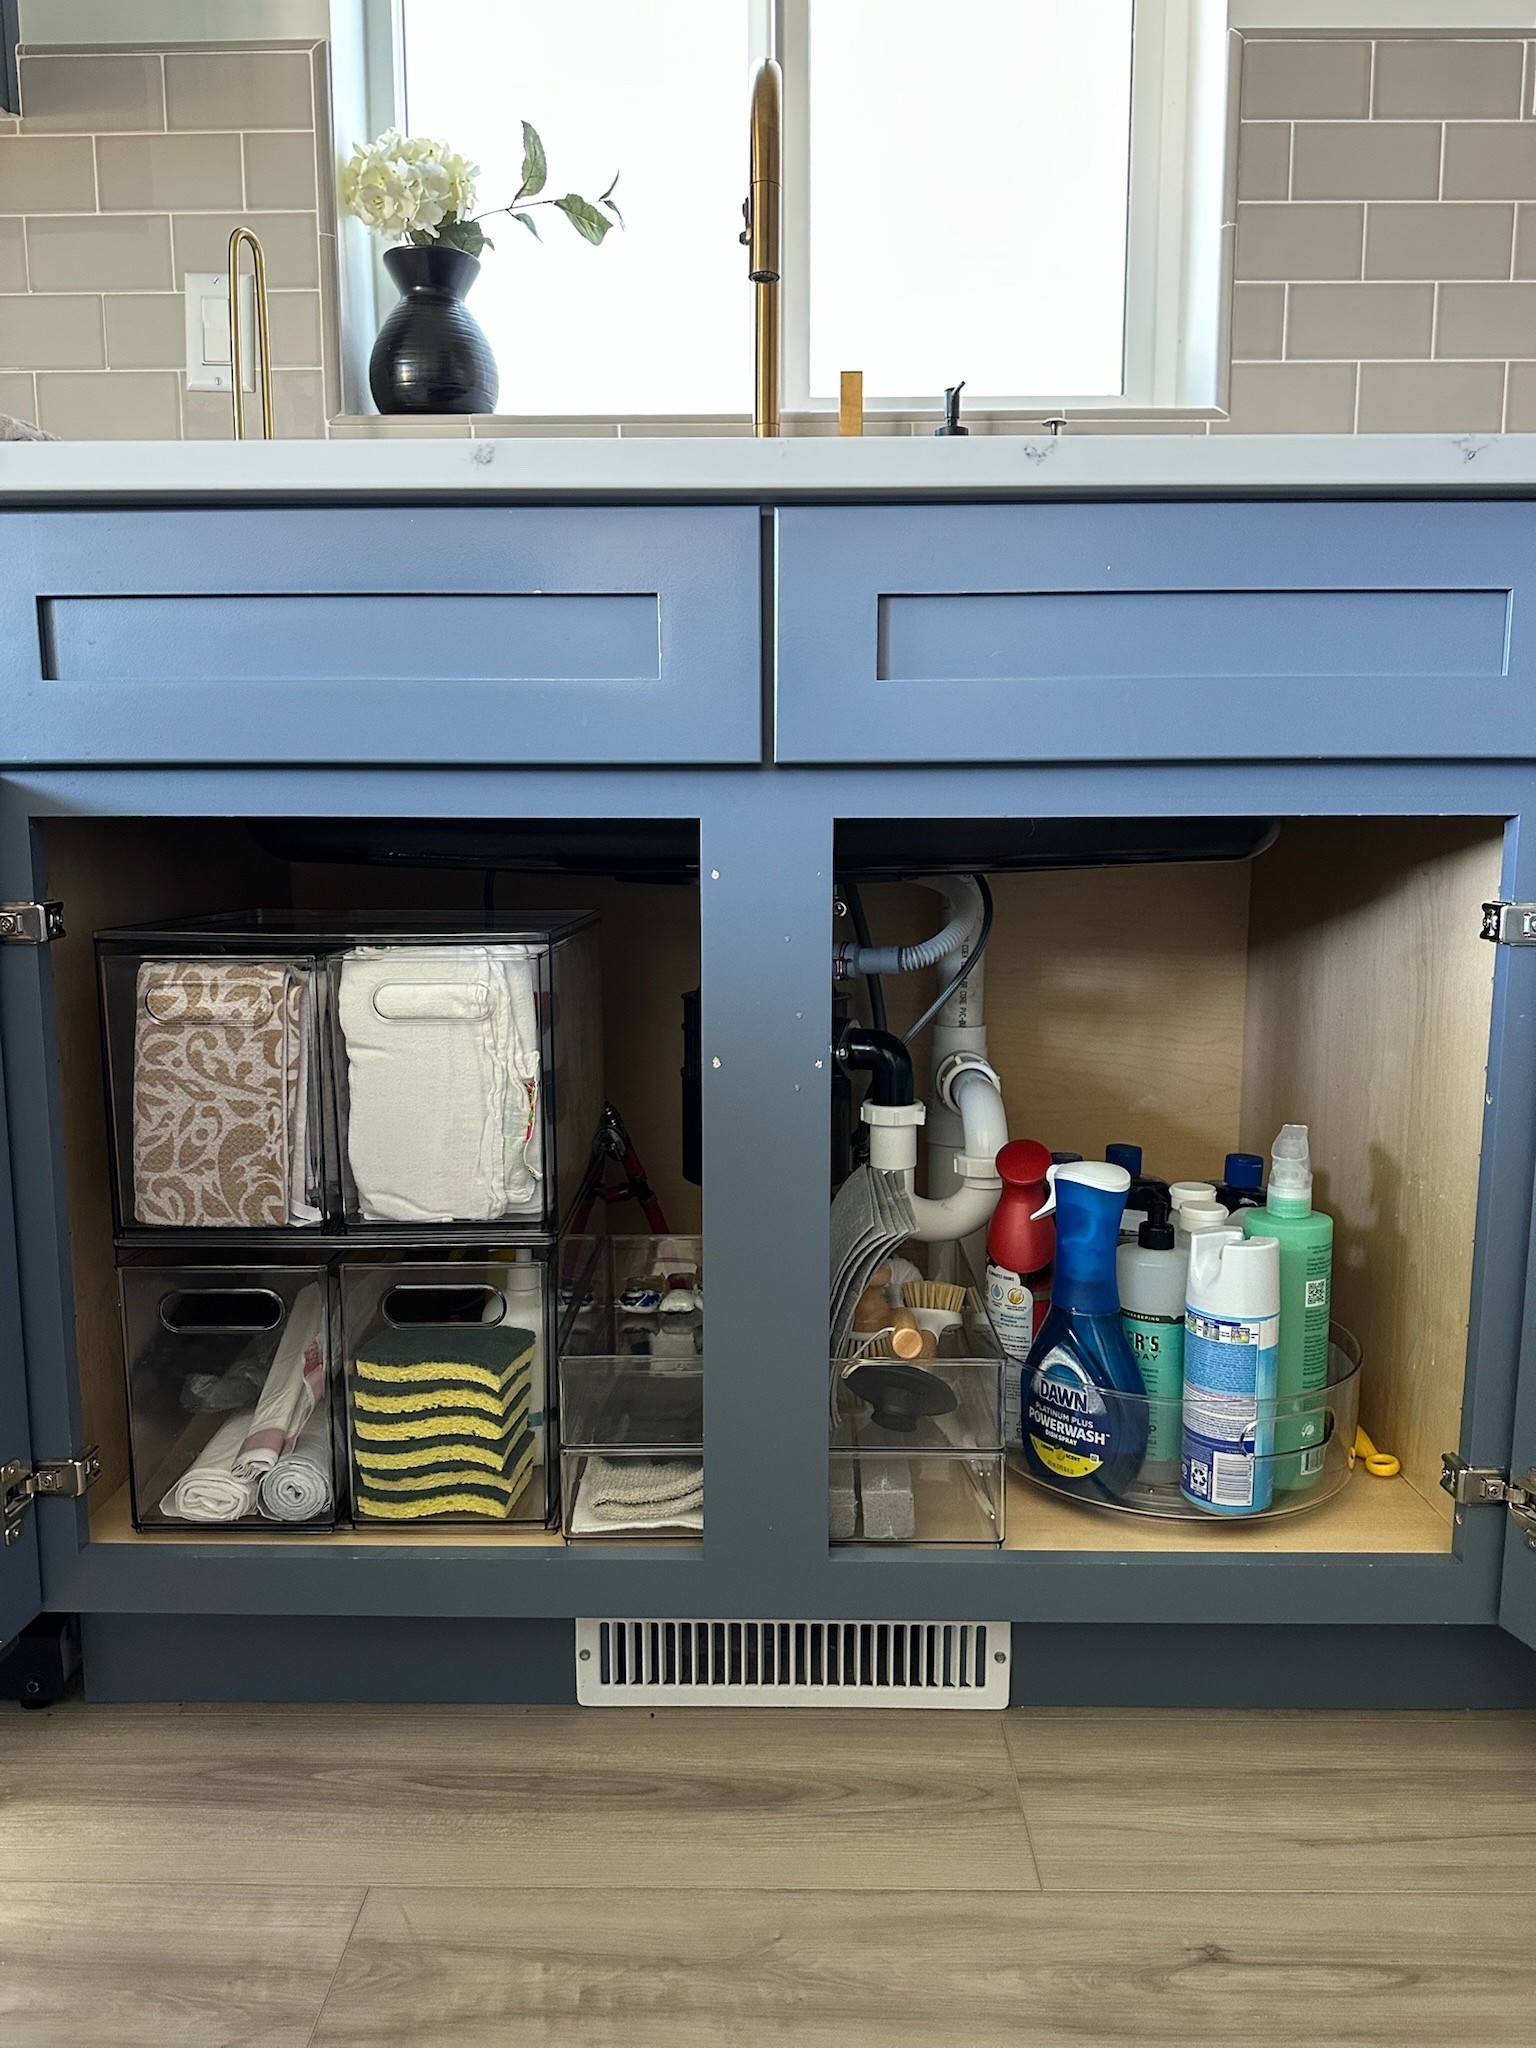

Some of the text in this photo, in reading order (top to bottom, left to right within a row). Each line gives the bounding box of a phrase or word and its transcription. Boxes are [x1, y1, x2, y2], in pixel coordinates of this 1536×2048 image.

[1040, 1379, 1089, 1414] DAWN
[1035, 1401, 1094, 1429] PLATINUM PLUS
[1045, 1428, 1078, 1447] DISH SPRAY
